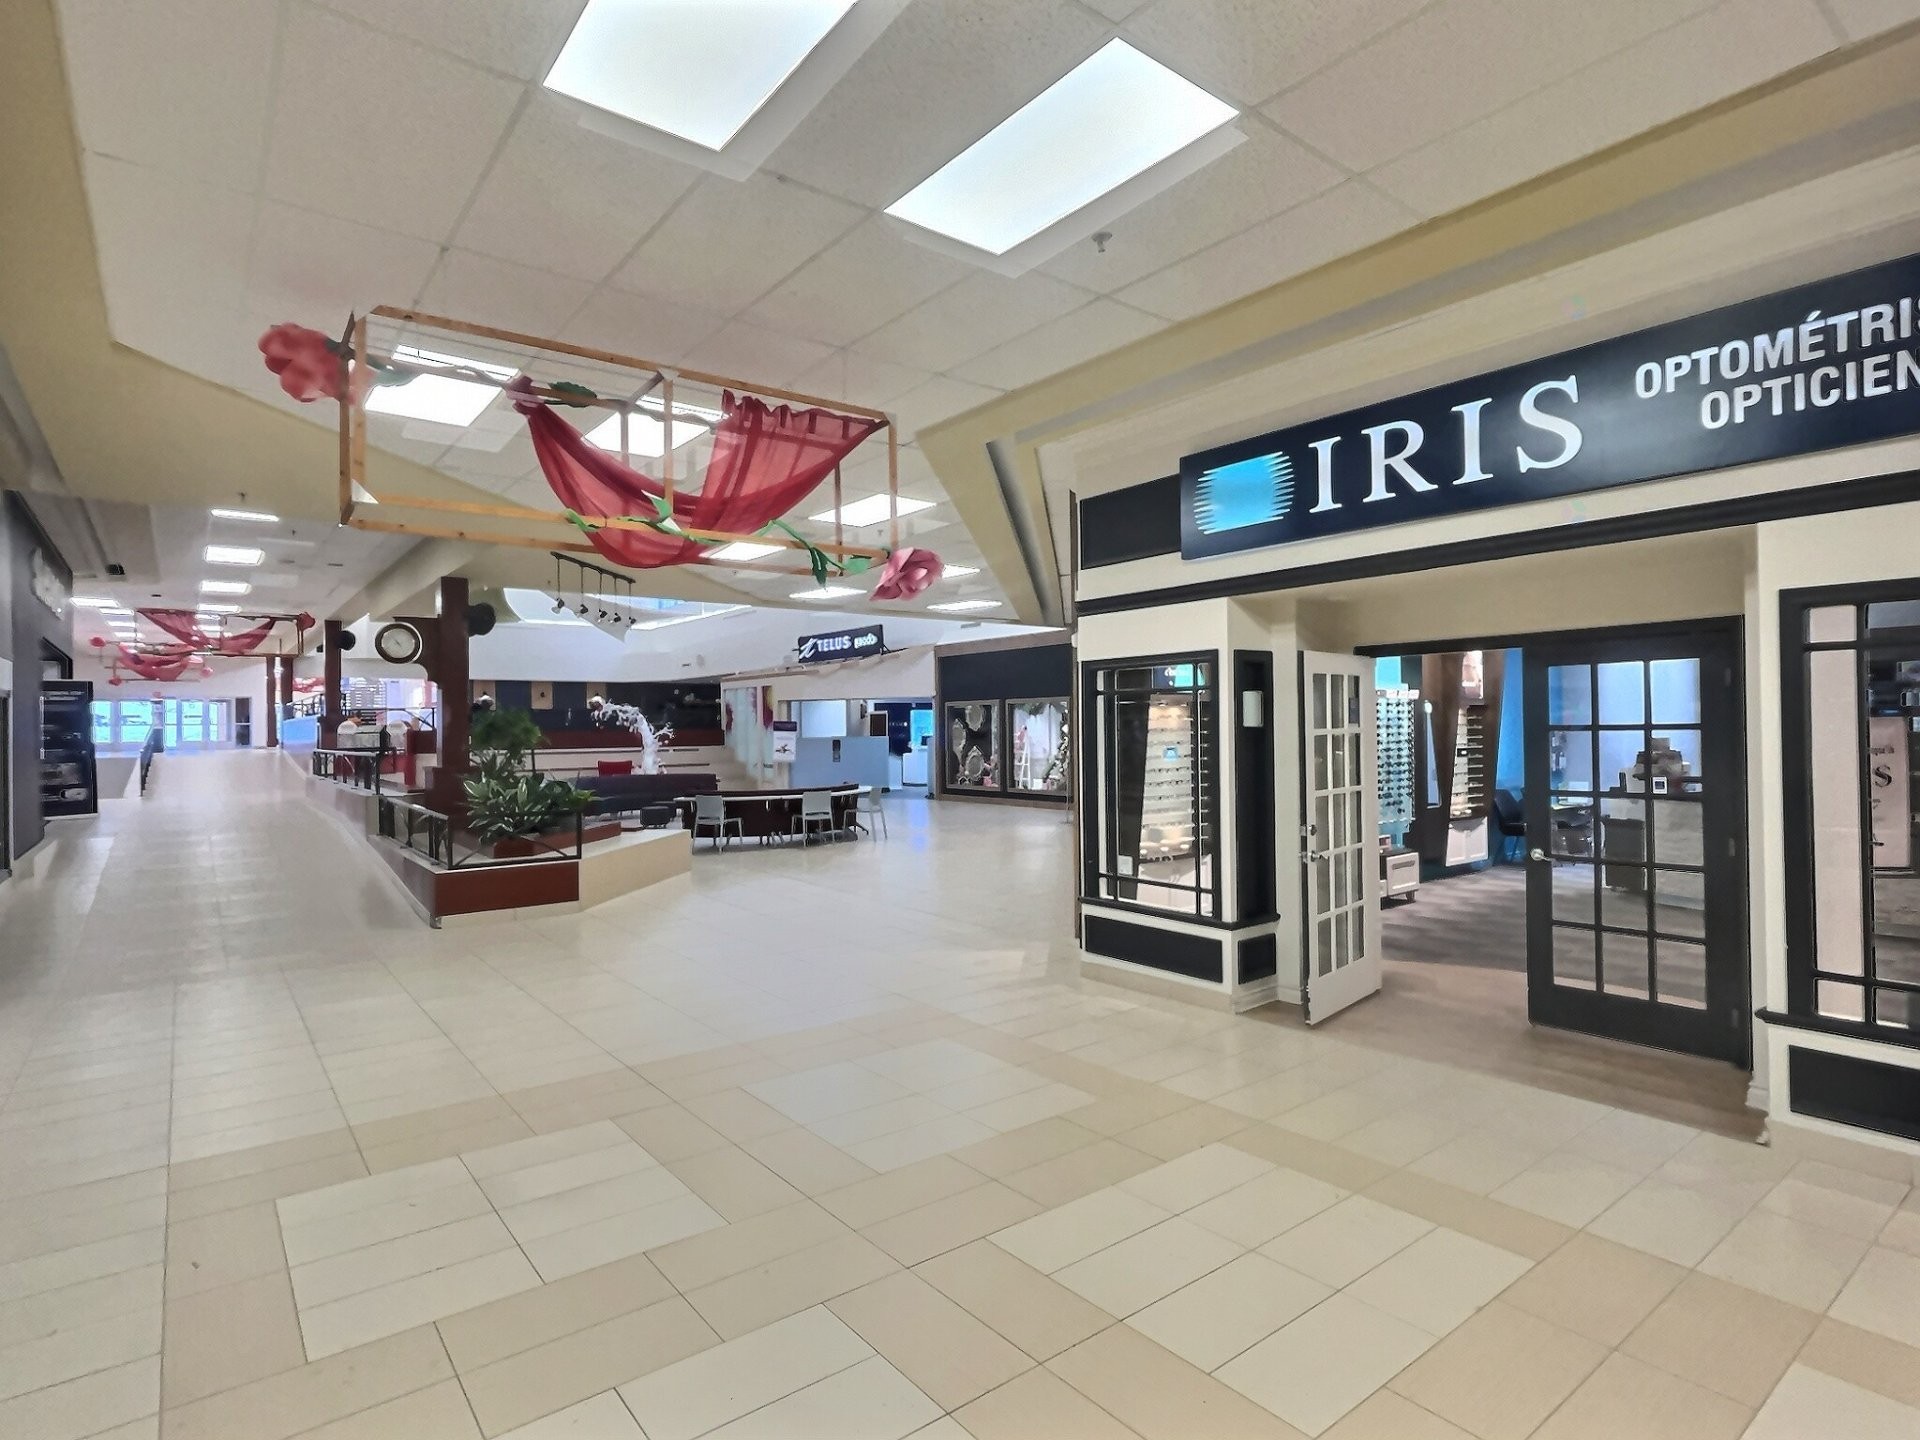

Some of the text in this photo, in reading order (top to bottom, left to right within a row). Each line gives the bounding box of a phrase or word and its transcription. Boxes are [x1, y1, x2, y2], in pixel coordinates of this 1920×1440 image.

[1635, 296, 1920, 399] OPTOMÉTRI
[1308, 374, 1583, 513] IRIS
[816, 635, 852, 652] TELUS
